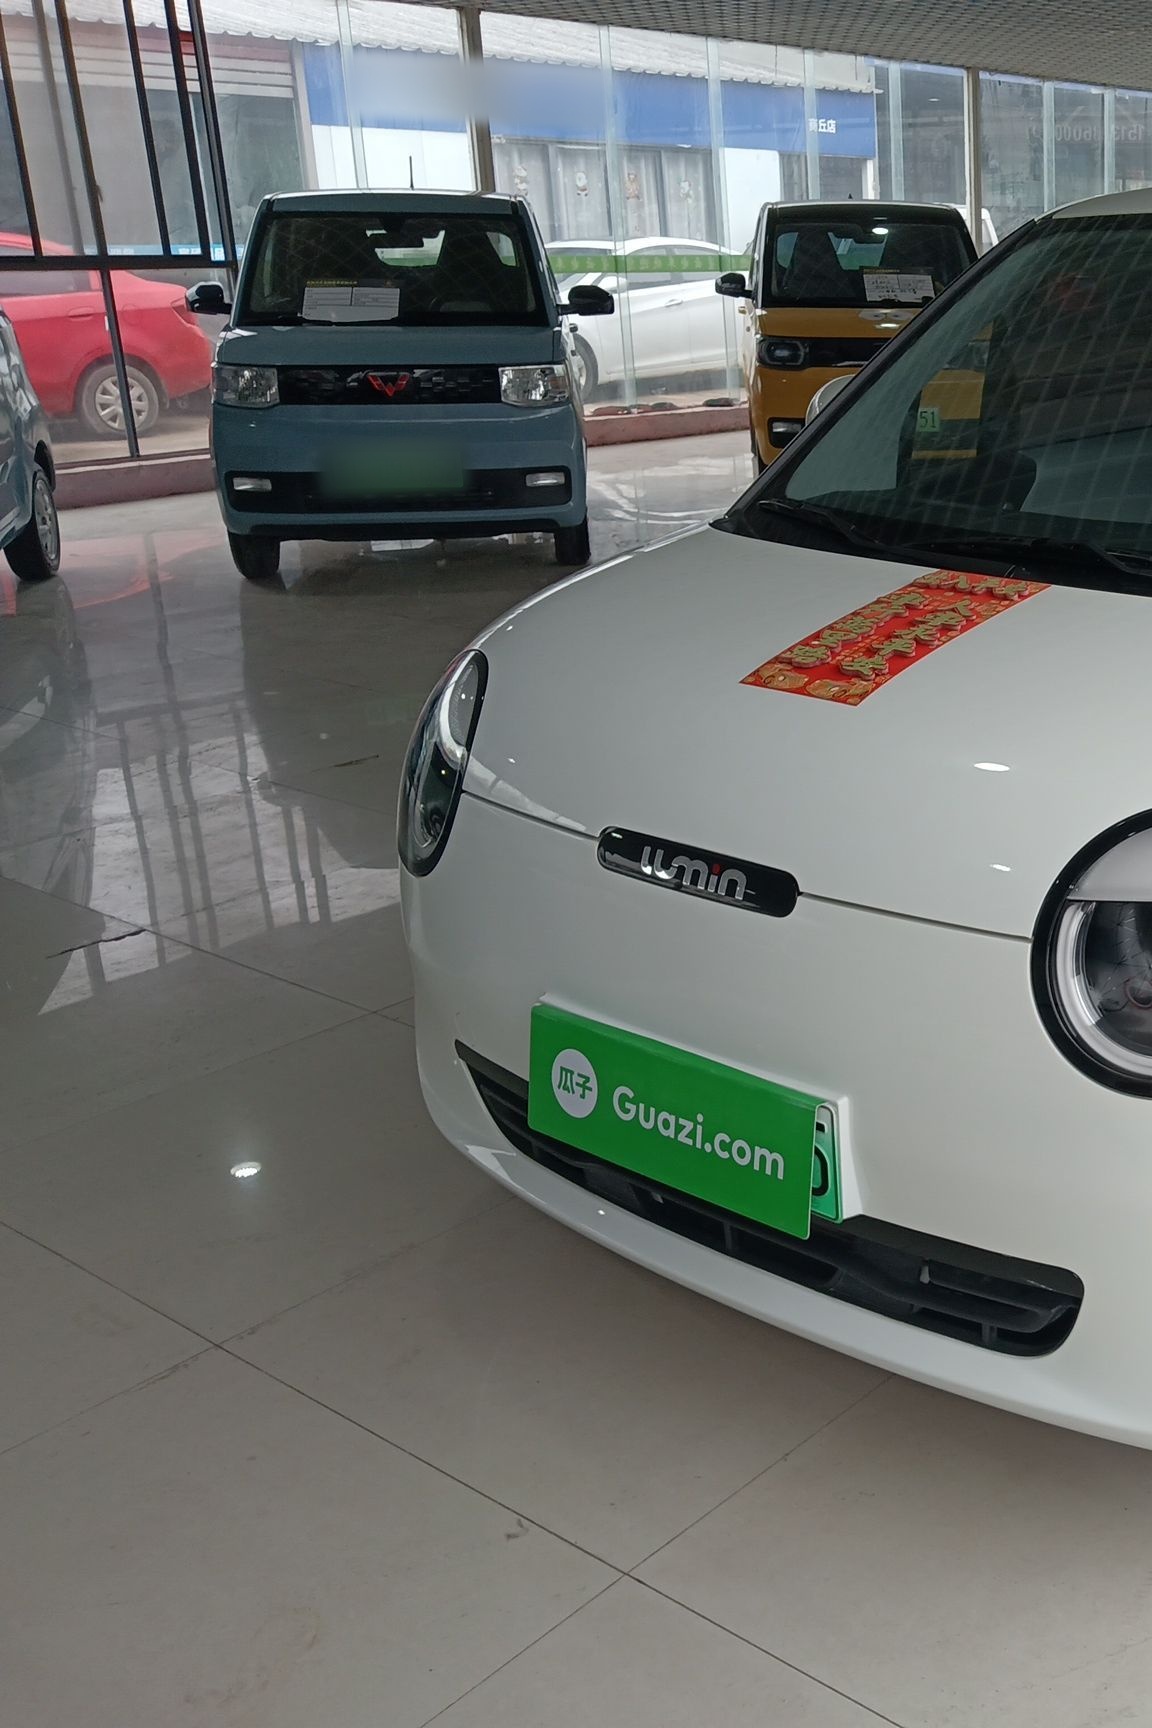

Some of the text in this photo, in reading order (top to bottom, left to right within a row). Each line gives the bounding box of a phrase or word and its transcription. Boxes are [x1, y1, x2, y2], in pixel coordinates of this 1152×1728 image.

[920, 411, 937, 428] 51
[557, 1066, 593, 1100] 瓜子
[612, 1085, 785, 1180] Guazi.com
